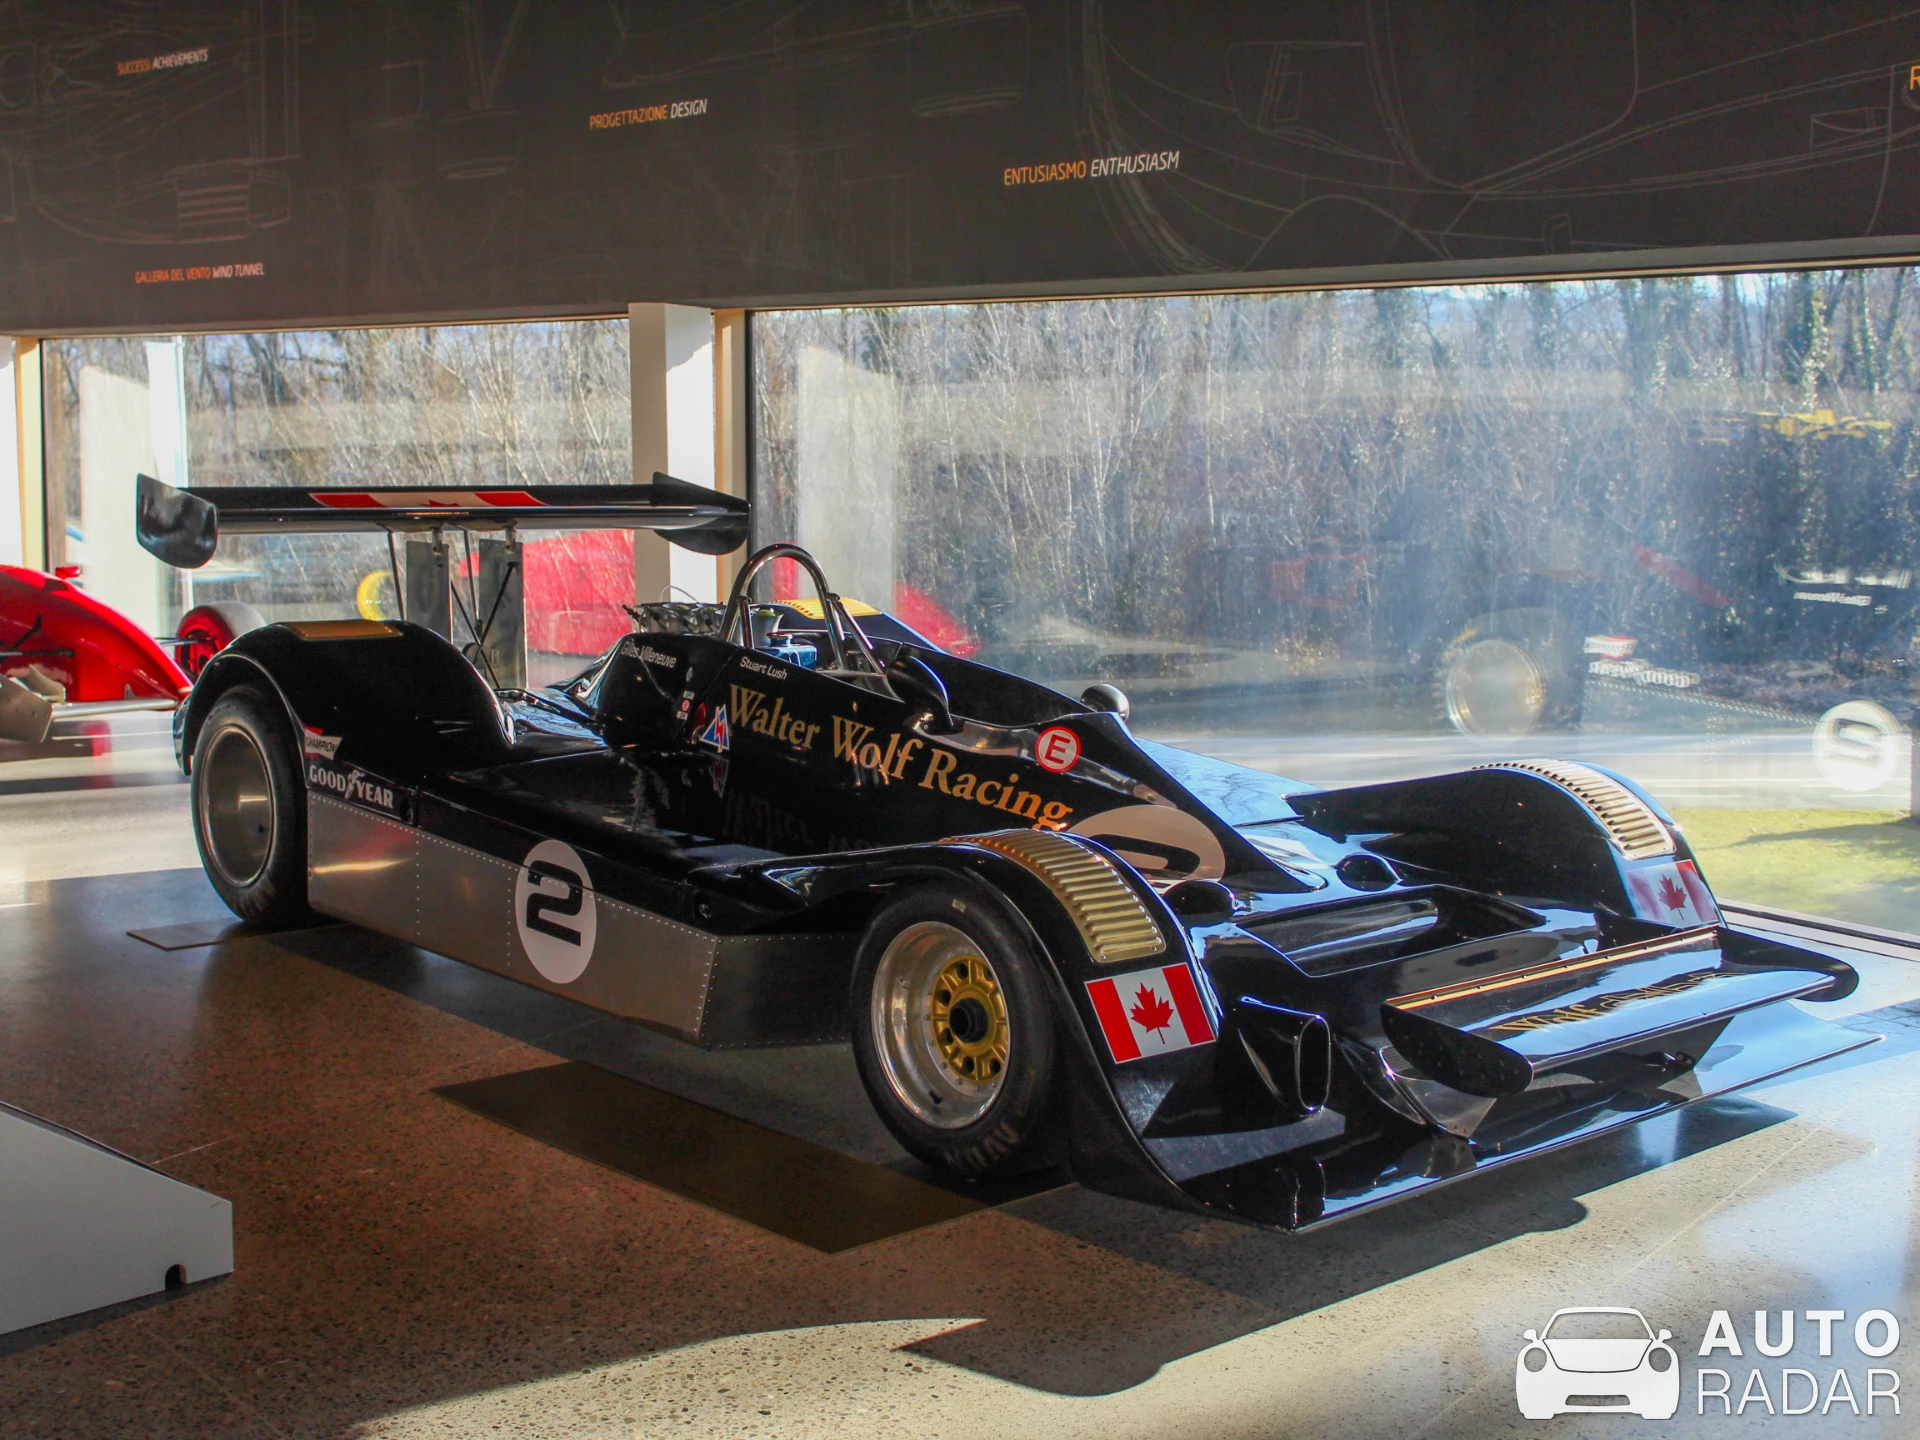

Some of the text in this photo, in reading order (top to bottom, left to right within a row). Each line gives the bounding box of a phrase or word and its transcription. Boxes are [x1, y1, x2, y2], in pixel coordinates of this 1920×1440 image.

[152, 48, 208, 69] ACHIEVEMENTS
[590, 99, 708, 130] PROGETTAZIONE DESIGN
[1004, 151, 1180, 186] ENTUSIASMO ENTHUSIASM
[135, 263, 264, 284] GALLERIA DEL VENTO WIND TUNNEL
[640, 645, 677, 669] Villeneuve
[740, 656, 787, 681] Stuart Lush
[305, 737, 338, 753] CHAMPION
[730, 684, 820, 749] Walter
[832, 714, 923, 780] Wolf
[918, 748, 1074, 832] Racing
[1044, 734, 1071, 765] E
[526, 860, 584, 947] 2
